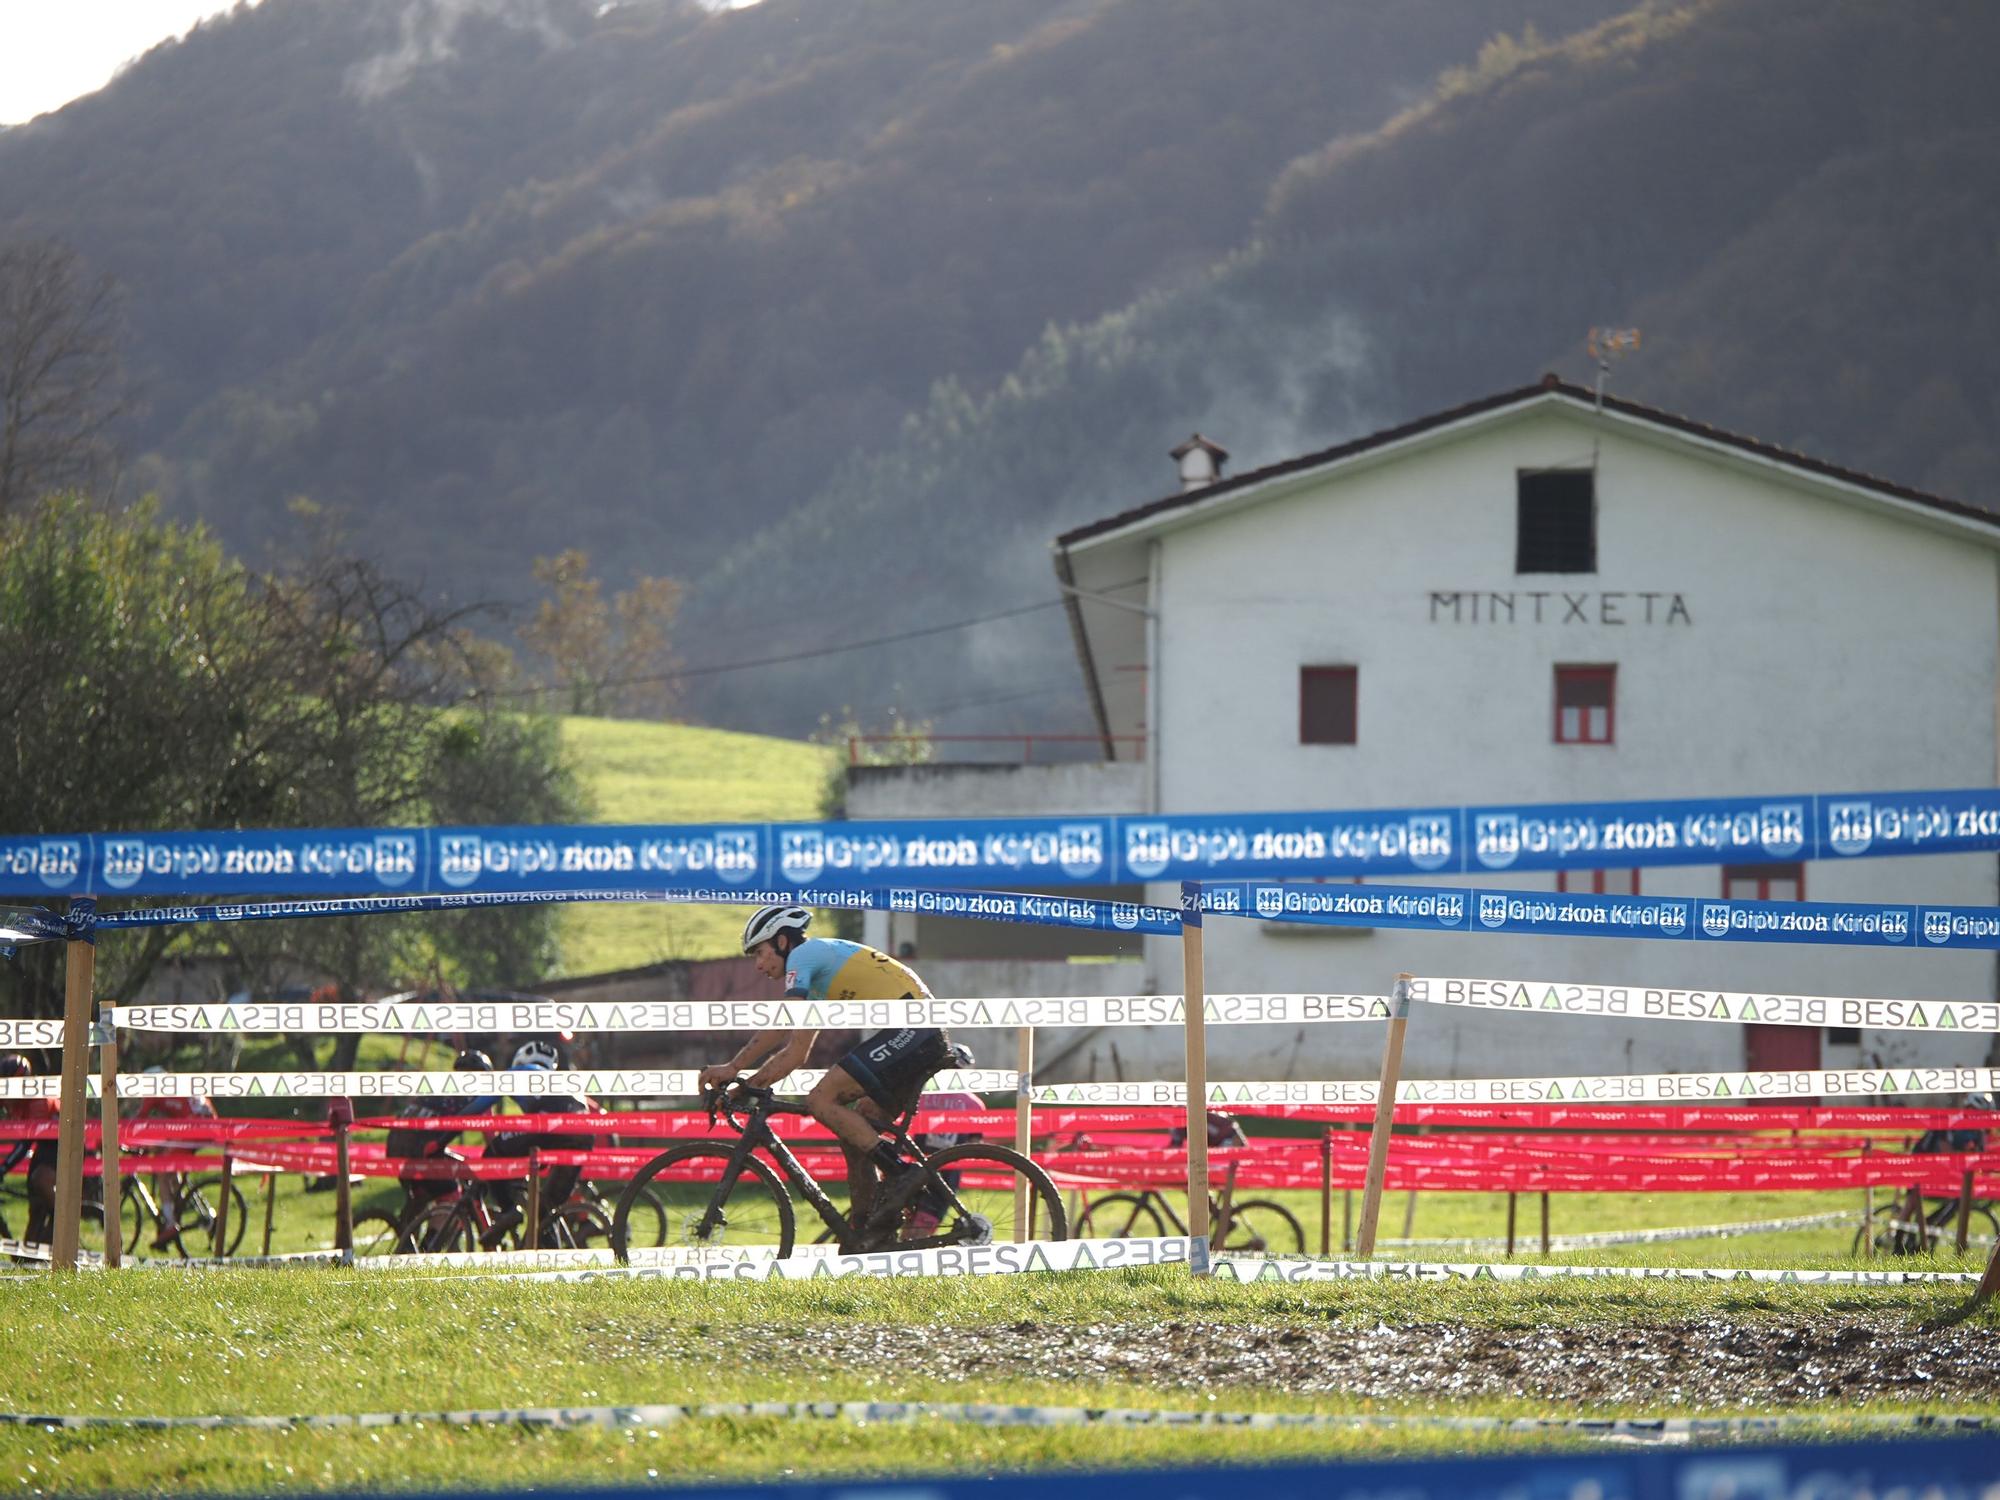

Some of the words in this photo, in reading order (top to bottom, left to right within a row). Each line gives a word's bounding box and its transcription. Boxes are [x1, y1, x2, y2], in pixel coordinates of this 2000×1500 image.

[1428, 591, 1692, 626] MINTXETA
[0, 841, 80, 876] rolak
[695, 888, 792, 904] Gipuzkoa
[799, 888, 873, 907] Kirolak
[919, 892, 1015, 916] Gipuzkoa
[1022, 897, 1096, 920] Kirolak
[1284, 891, 1382, 917] Gipuzkoa
[1387, 893, 1464, 919] Kirolak
[1508, 900, 1605, 924] Gipuzkoa
[1611, 902, 1686, 927] Kirolak
[1730, 909, 1827, 933] Gipuzkoa
[1832, 912, 1908, 936] Kirolak
[1445, 980, 1532, 1008] BESA
[1644, 990, 1731, 1019] BESA
[128, 1007, 213, 1029] BESA
[318, 1005, 404, 1029] BESA
[512, 1004, 599, 1029] BESA
[708, 1002, 795, 1027] BESA
[905, 1000, 993, 1025] BESA
[1104, 997, 1185, 1022] BESA
[1303, 996, 1391, 1019] BESA
[1842, 1000, 1929, 1028] BESA
[190, 1075, 266, 1097] BESA
[359, 1074, 434, 1095] BESA
[528, 1073, 603, 1094] BESA
[1322, 1084, 1375, 1102] BES
[1490, 1081, 1564, 1100] BESA
[1657, 1076, 1732, 1098] BESA
[1824, 1071, 1899, 1093] BESA
[936, 1244, 1053, 1275] BESA
